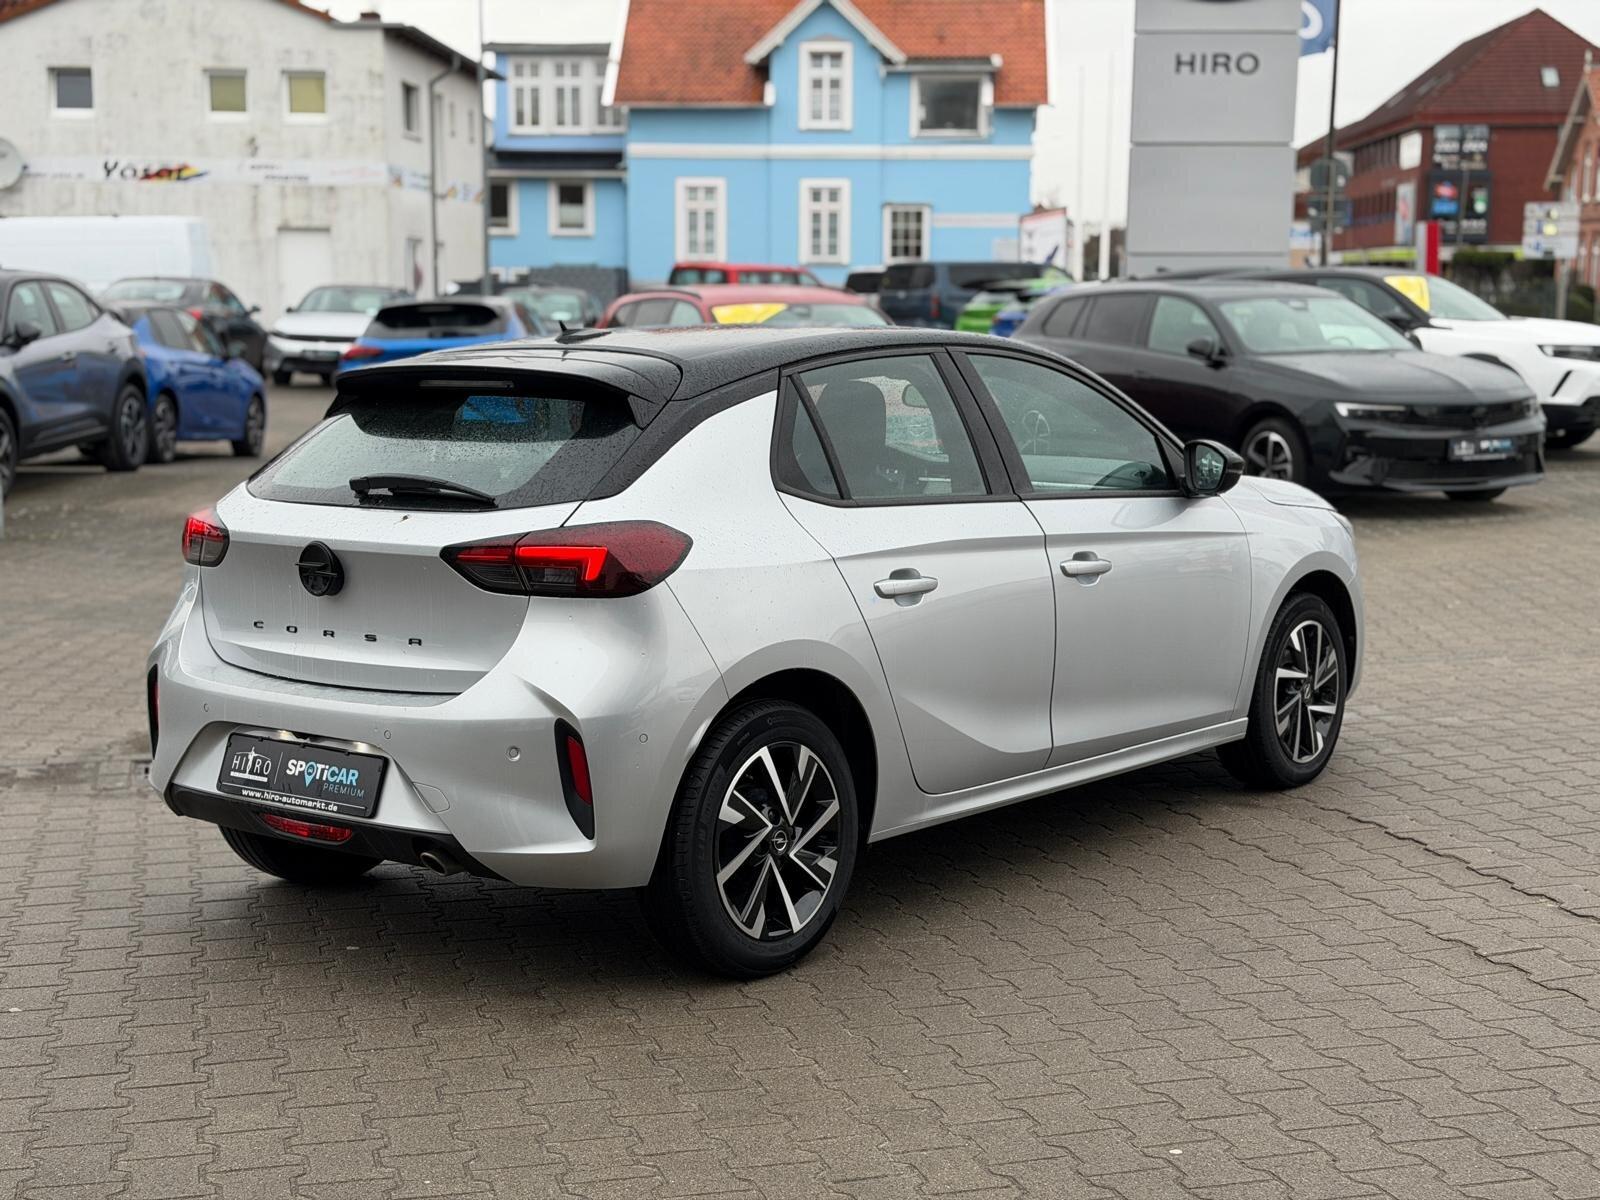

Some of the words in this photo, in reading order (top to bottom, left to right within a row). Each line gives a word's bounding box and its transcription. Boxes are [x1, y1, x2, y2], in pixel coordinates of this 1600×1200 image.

[1175, 53, 1260, 75] HIRO
[253, 620, 422, 646] CORSA
[242, 788, 338, 812] www.hiro-automarkt.de
[323, 782, 365, 798] PREMIUM
